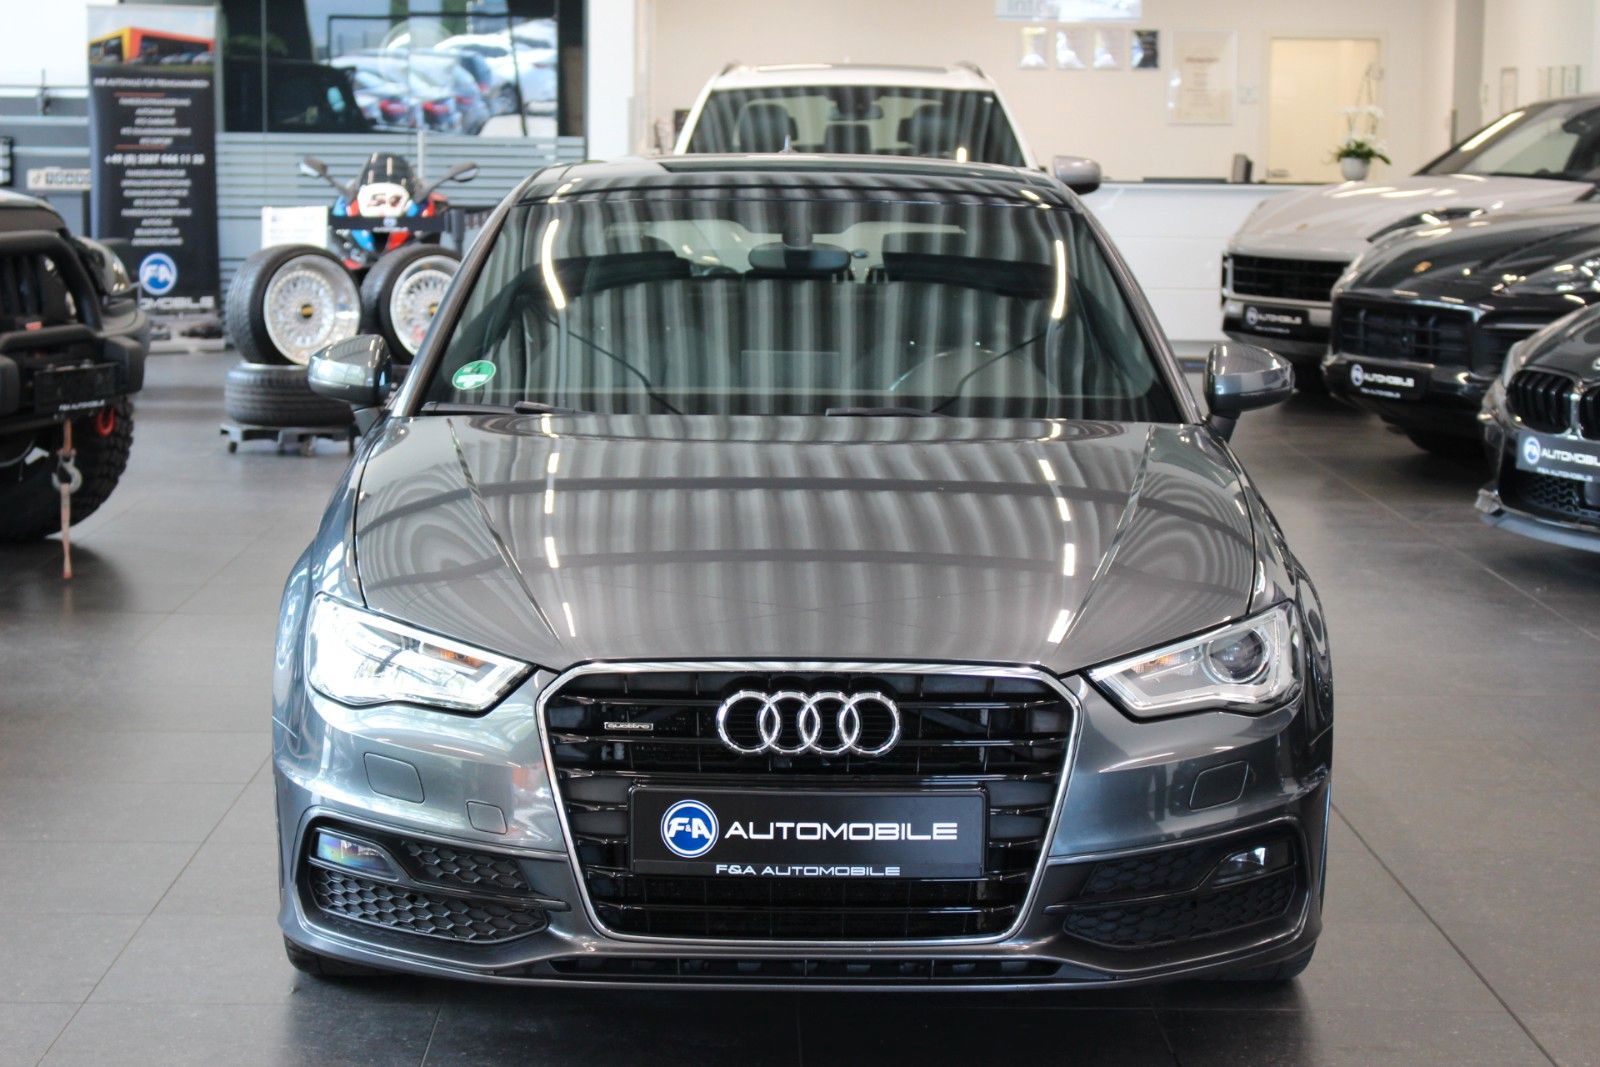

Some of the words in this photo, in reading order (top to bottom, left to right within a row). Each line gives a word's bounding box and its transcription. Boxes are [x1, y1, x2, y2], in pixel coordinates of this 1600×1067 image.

[1541, 447, 1600, 467] AUTOMOBIL
[607, 722, 650, 730] quattro
[668, 817, 712, 840] F&A
[724, 821, 958, 841] AUTOMOBILE
[715, 864, 757, 875] F&A
[760, 865, 901, 877] AUTOMOBILE
